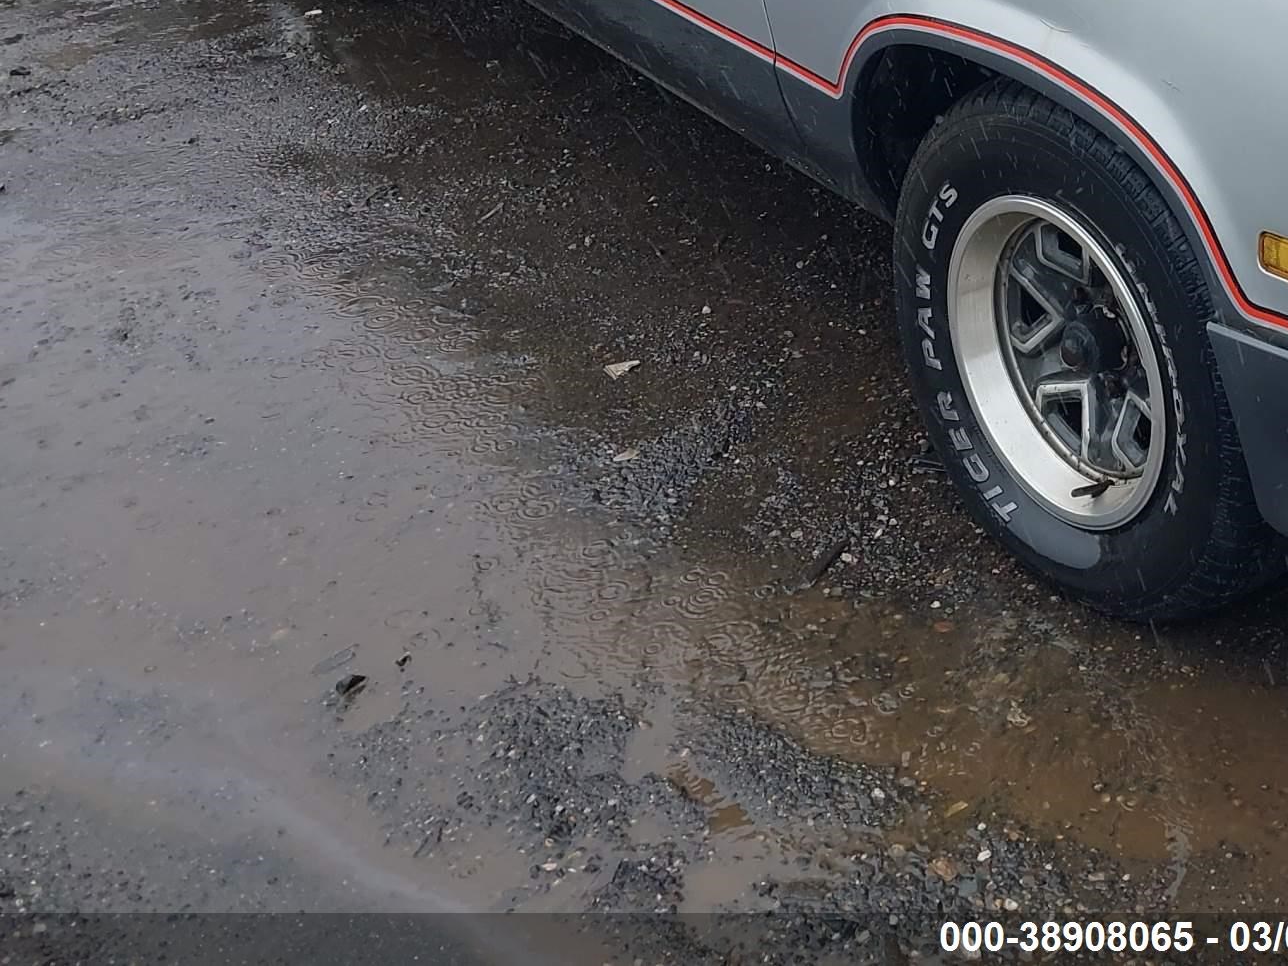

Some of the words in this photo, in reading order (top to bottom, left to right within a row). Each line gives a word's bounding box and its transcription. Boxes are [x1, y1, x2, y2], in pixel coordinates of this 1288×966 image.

[921, 184, 958, 250] GTS
[915, 264, 942, 370] PAW
[937, 391, 1018, 523] TIGER
